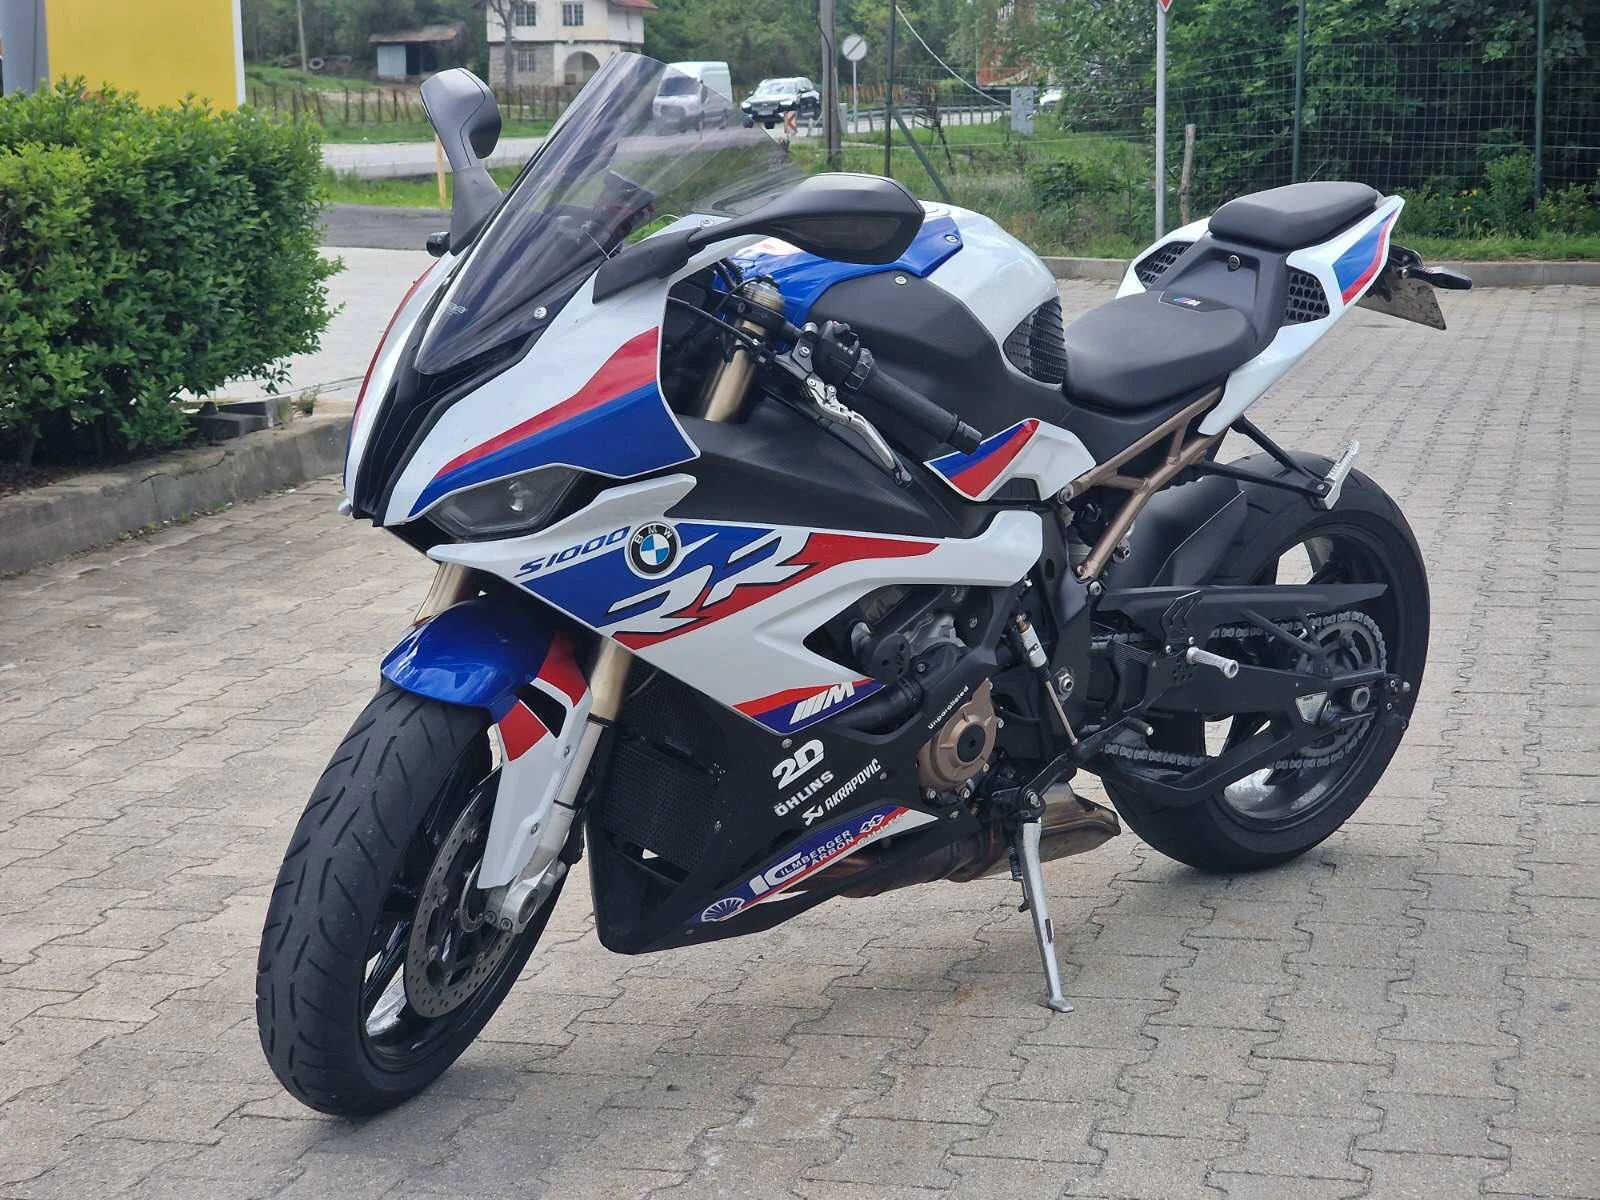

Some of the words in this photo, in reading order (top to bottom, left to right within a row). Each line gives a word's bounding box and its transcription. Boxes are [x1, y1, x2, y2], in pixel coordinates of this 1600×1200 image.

[513, 525, 631, 579] S1000
[634, 525, 673, 545] BMW
[773, 769, 835, 817] ÖHLINS
[780, 829, 853, 877] ILMBERGER
